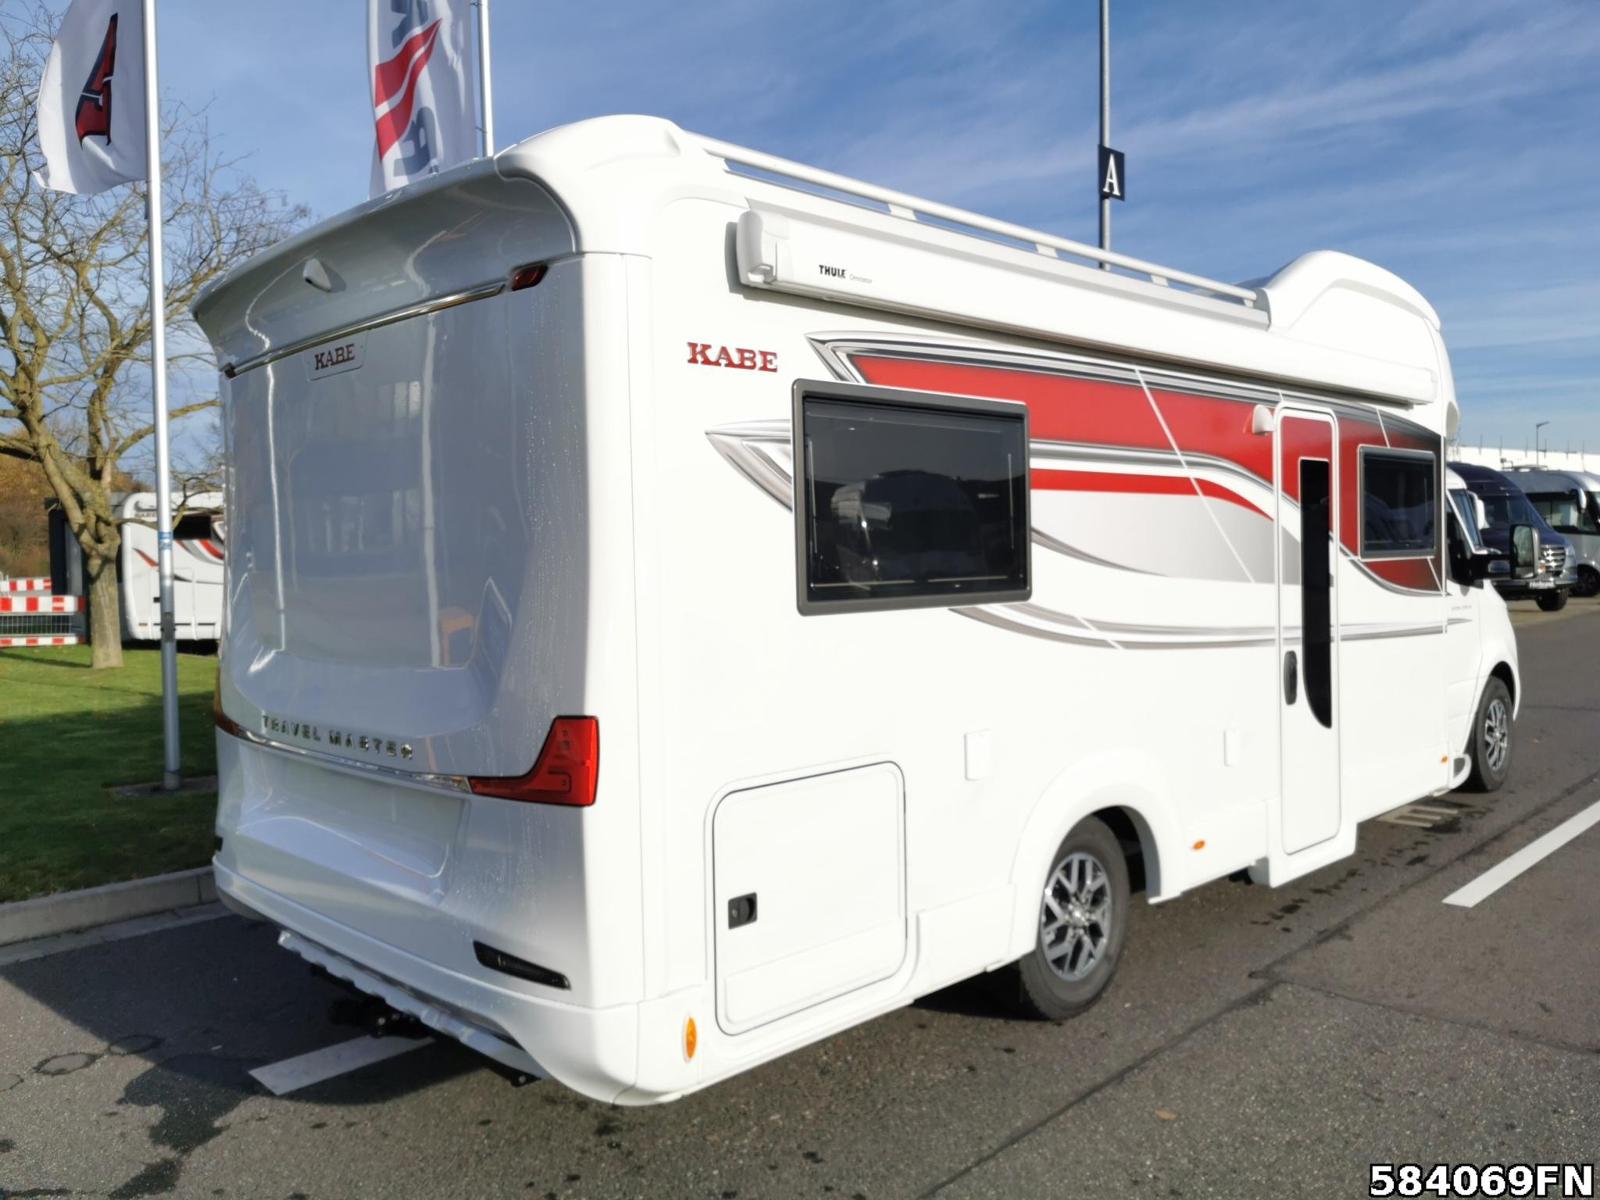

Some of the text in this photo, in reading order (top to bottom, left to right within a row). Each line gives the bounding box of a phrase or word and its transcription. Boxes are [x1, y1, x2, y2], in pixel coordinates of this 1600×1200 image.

[1103, 153, 1121, 196] A
[819, 264, 846, 279] THULE
[314, 343, 356, 371] KABE
[687, 341, 778, 373] KABE
